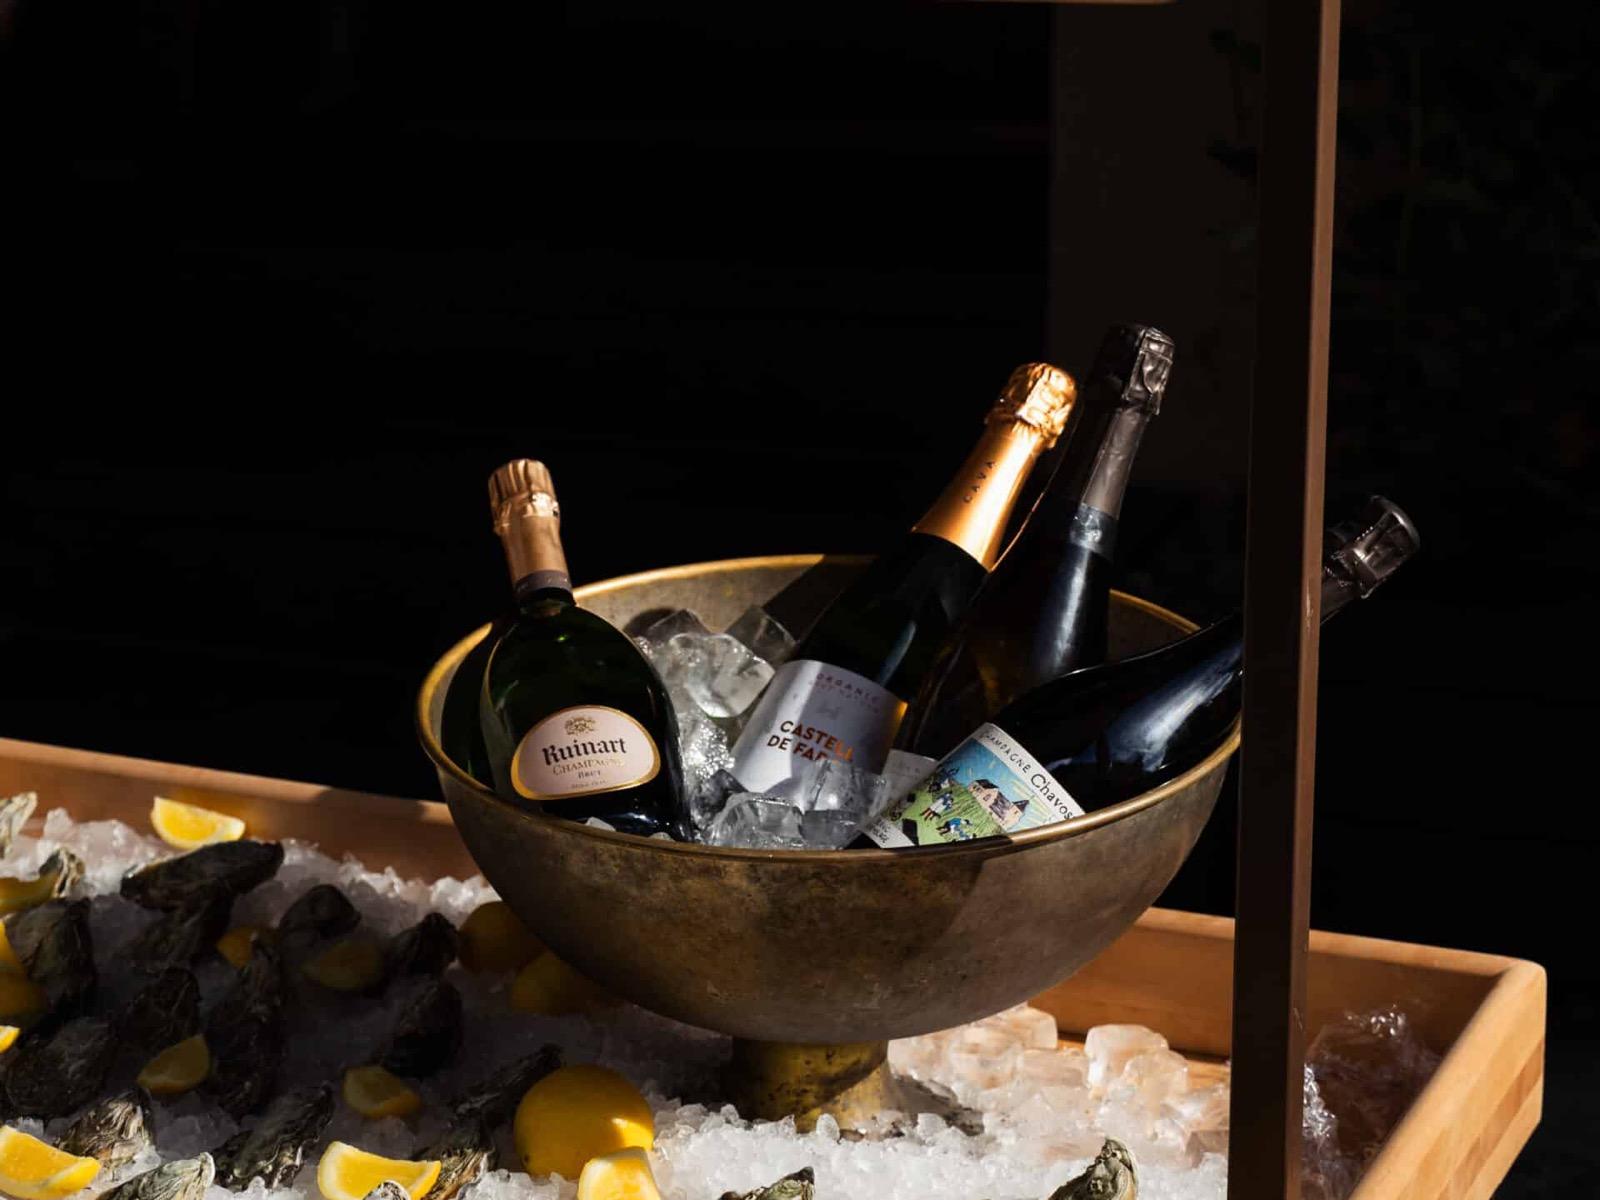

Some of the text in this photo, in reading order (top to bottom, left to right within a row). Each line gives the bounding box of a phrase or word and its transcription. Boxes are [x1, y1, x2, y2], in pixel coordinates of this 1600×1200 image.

[964, 461, 996, 503] CAVA
[542, 738, 627, 766] Ruinart
[767, 735, 830, 762] DE FAR
[981, 732, 1073, 820] HAMPAGNE Chavos
